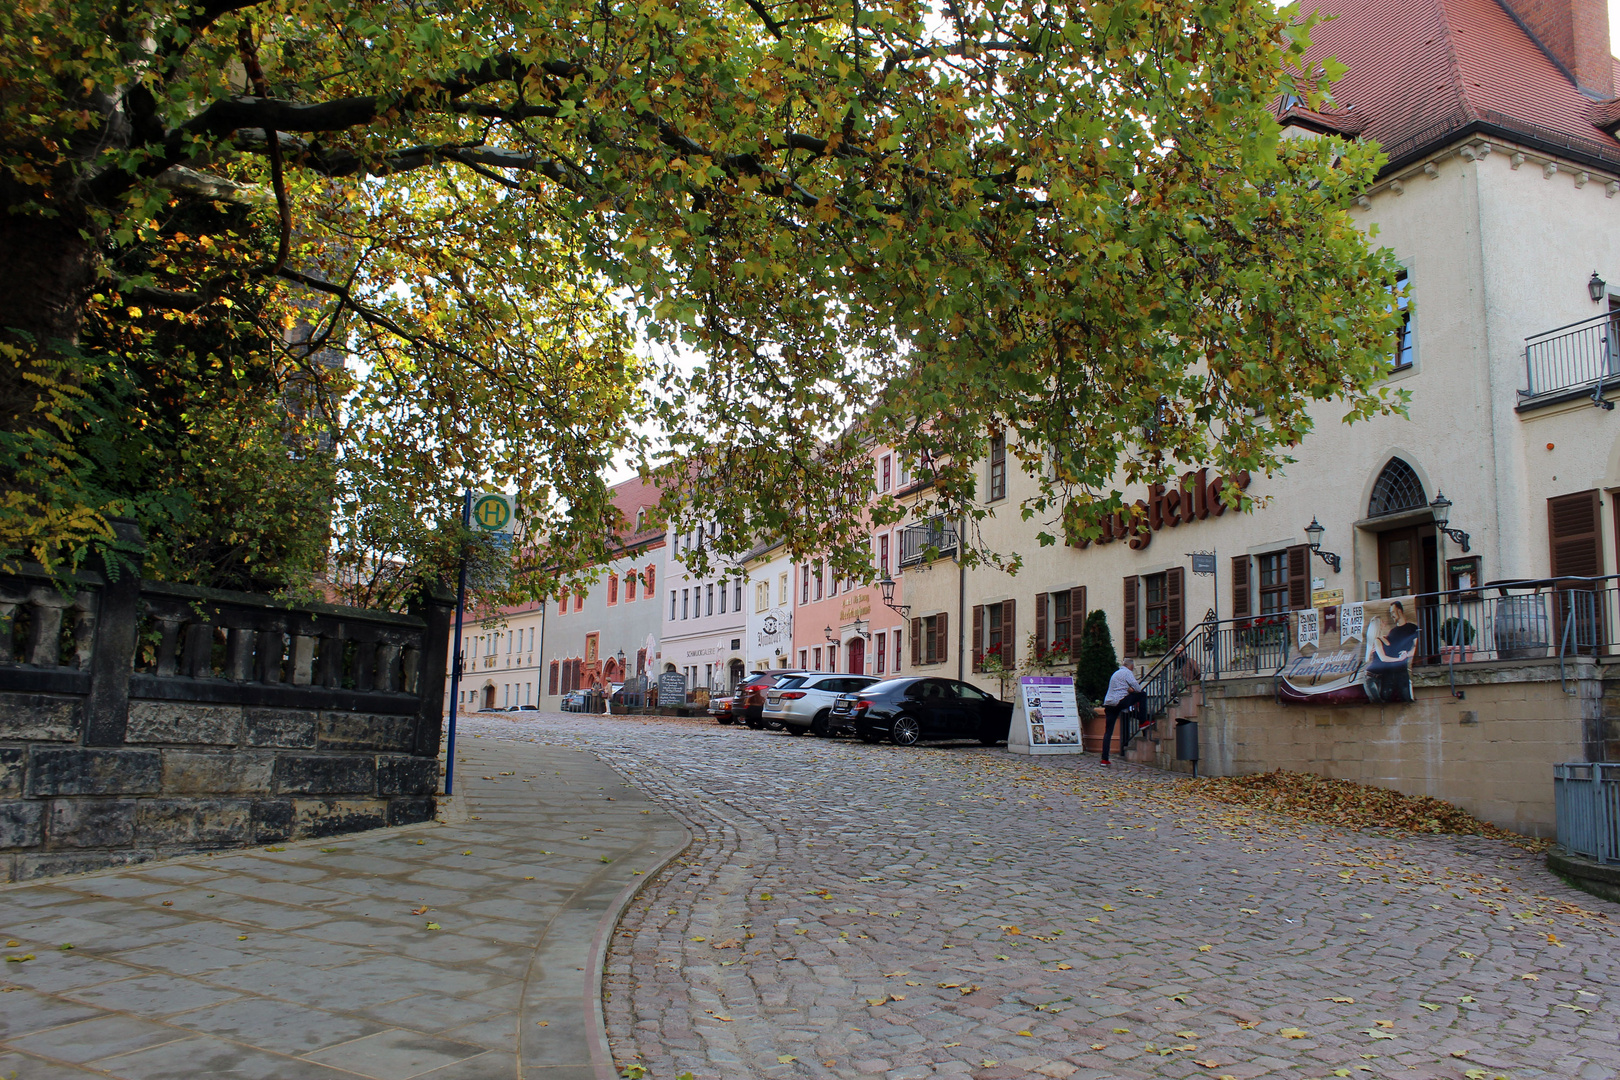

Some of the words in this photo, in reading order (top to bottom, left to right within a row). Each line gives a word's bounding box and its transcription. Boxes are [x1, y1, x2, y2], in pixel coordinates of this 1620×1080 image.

[484, 502, 500, 524] H
[1065, 467, 1251, 550] urgkeller
[1353, 606, 1363, 616] FEB
[1351, 616, 1363, 625] MRZ
[1308, 622, 1317, 632] DEZ
[1351, 626, 1361, 635] APR
[1308, 632, 1318, 641] JAN
[1288, 654, 1366, 685] Tanzparty
